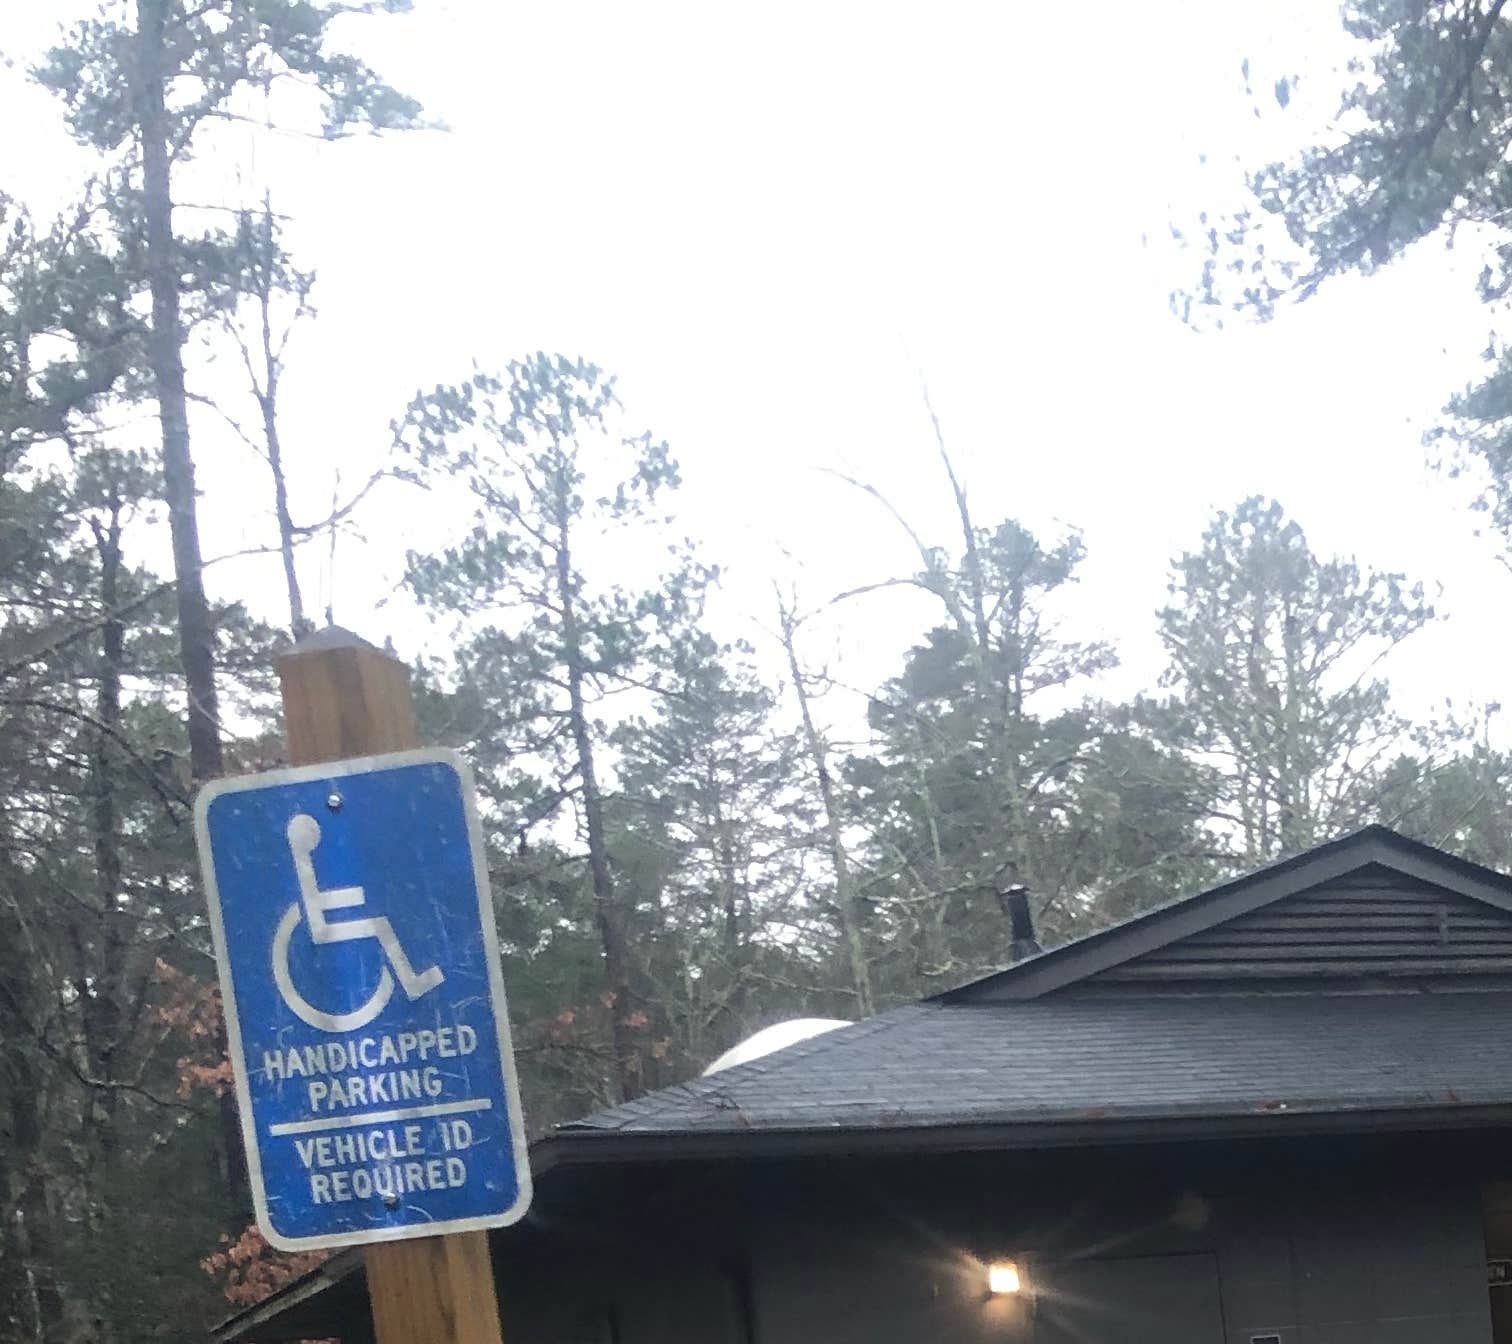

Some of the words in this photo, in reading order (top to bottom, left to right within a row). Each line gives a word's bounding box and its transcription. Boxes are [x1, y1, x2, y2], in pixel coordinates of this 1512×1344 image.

[264, 1024, 477, 1080] HANDICAPPED
[308, 1066, 443, 1112] PARKING
[294, 1128, 426, 1169] VEHICLE
[438, 1120, 474, 1151] ID
[310, 1157, 467, 1204] REQUIRED
